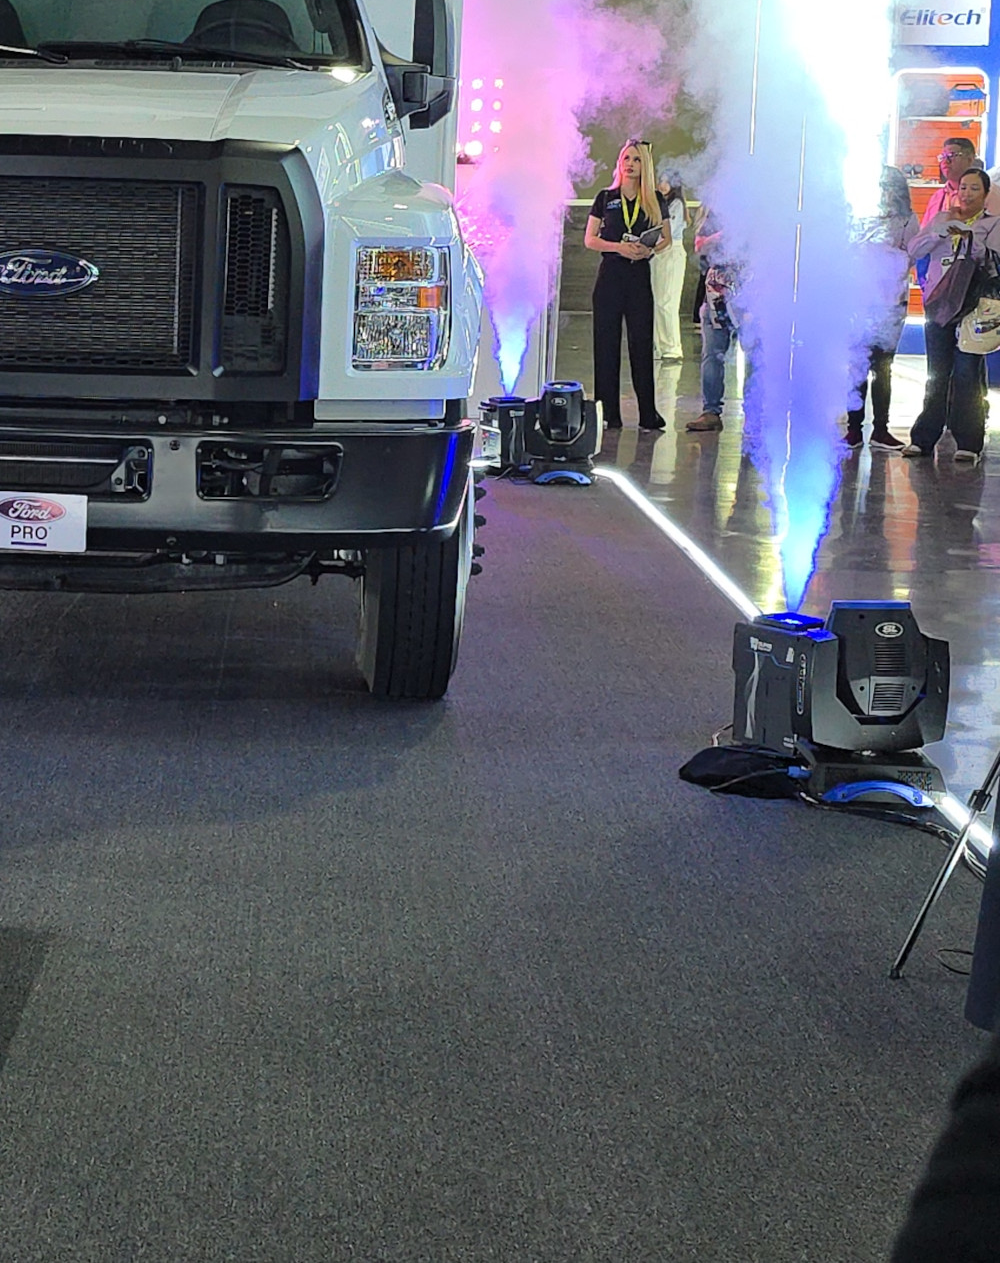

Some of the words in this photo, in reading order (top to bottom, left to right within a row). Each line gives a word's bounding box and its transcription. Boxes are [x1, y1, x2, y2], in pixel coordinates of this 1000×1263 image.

[1, 256, 69, 285] Ford
[8, 500, 52, 520] Ford
[11, 525, 48, 540] PRO
